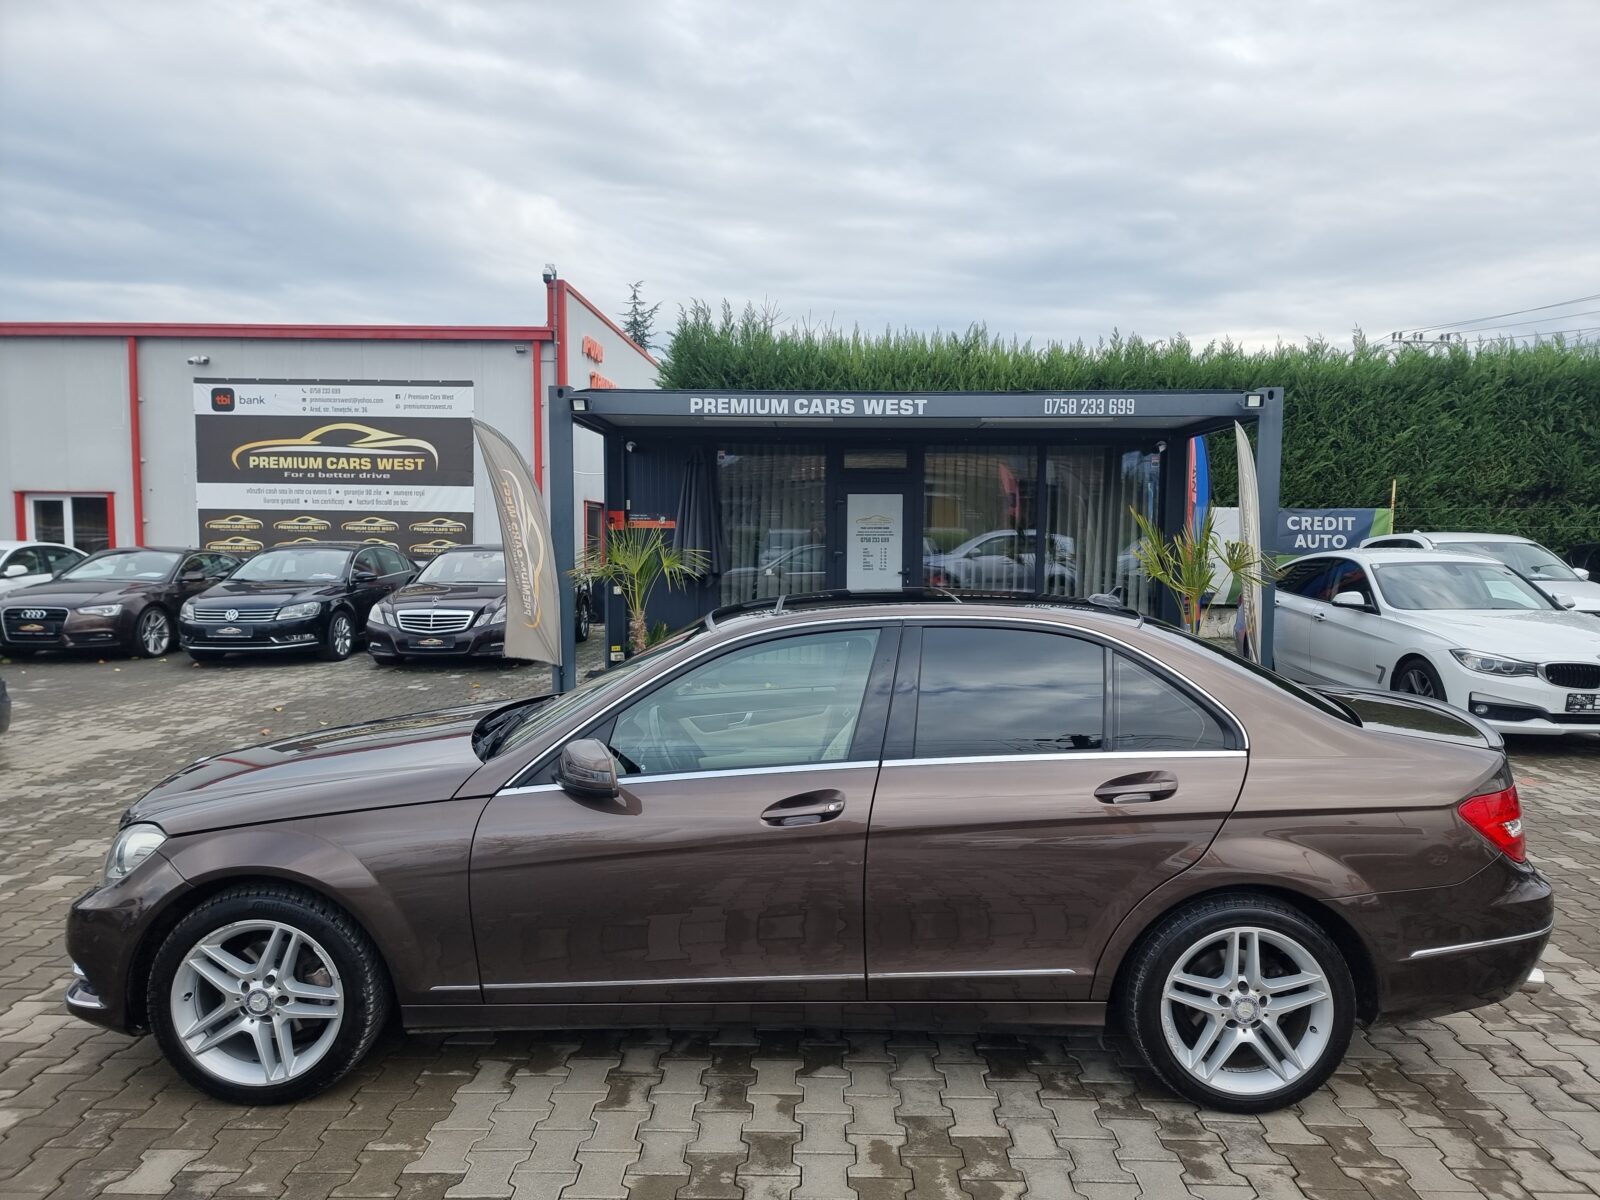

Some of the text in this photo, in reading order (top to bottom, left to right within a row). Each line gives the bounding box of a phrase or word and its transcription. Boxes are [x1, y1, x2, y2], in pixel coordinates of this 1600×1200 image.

[215, 394, 266, 406] tbi bank
[690, 398, 928, 415] PREMIUM CARS WEST
[1044, 398, 1135, 415] 0758 233 699
[249, 456, 425, 471] PREMIUM CARS WEST
[359, 472, 391, 480] drive
[1286, 515, 1356, 531] CREDIT
[1294, 533, 1348, 549] AUTO
